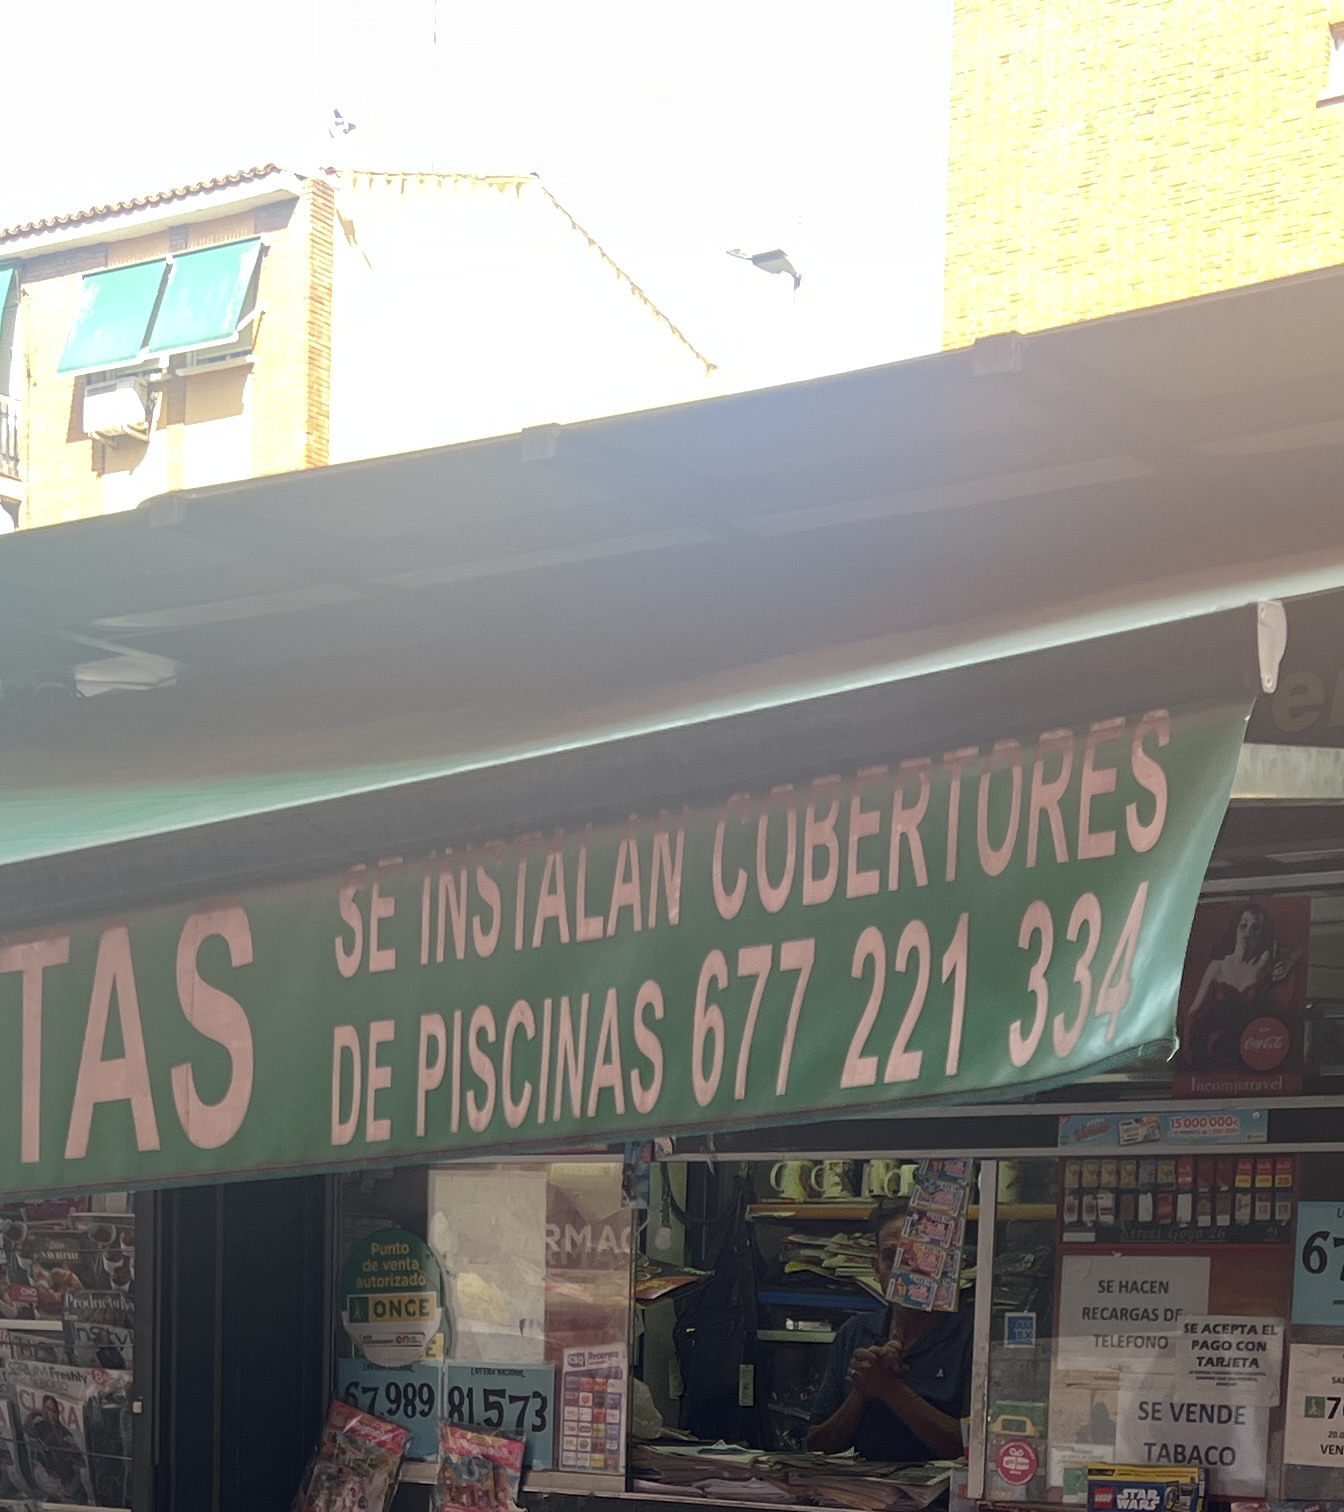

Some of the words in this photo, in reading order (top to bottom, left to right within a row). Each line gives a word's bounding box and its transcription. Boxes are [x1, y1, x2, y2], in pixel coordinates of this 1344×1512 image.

[333, 857, 404, 978] SE
[419, 806, 687, 966] INSTALAN
[710, 708, 1173, 922] COBERTORES
[330, 1019, 396, 1147] DE
[415, 977, 666, 1139] PISCINAS
[691, 938, 817, 1108] 677
[839, 910, 971, 1091] 221
[1007, 880, 1151, 1070] 334
[370, 1241, 410, 1257] Punto
[362, 1258, 379, 1273] de
[383, 1259, 421, 1273] venta
[356, 1273, 427, 1289] autorizado
[1097, 1279, 1114, 1294] SE
[1118, 1279, 1170, 1295] HACEN
[373, 1298, 430, 1319] ONCE
[1081, 1306, 1160, 1322] RECARGAS
[1182, 1322, 1198, 1335] SE
[1200, 1323, 1258, 1336] ACEPTA
[1261, 1324, 1278, 1336] EL
[1092, 1333, 1169, 1350] TELEFONO
[1190, 1339, 1232, 1352] PAGO
[1235, 1340, 1268, 1352] CON
[1195, 1355, 1261, 1370] TARJETA
[1137, 1400, 1163, 1422] SE
[1169, 1401, 1247, 1426] VENDE
[1143, 1441, 1237, 1468] TABACO
[1117, 1487, 1161, 1501] STAR
[1116, 1498, 1161, 1512] WARS
